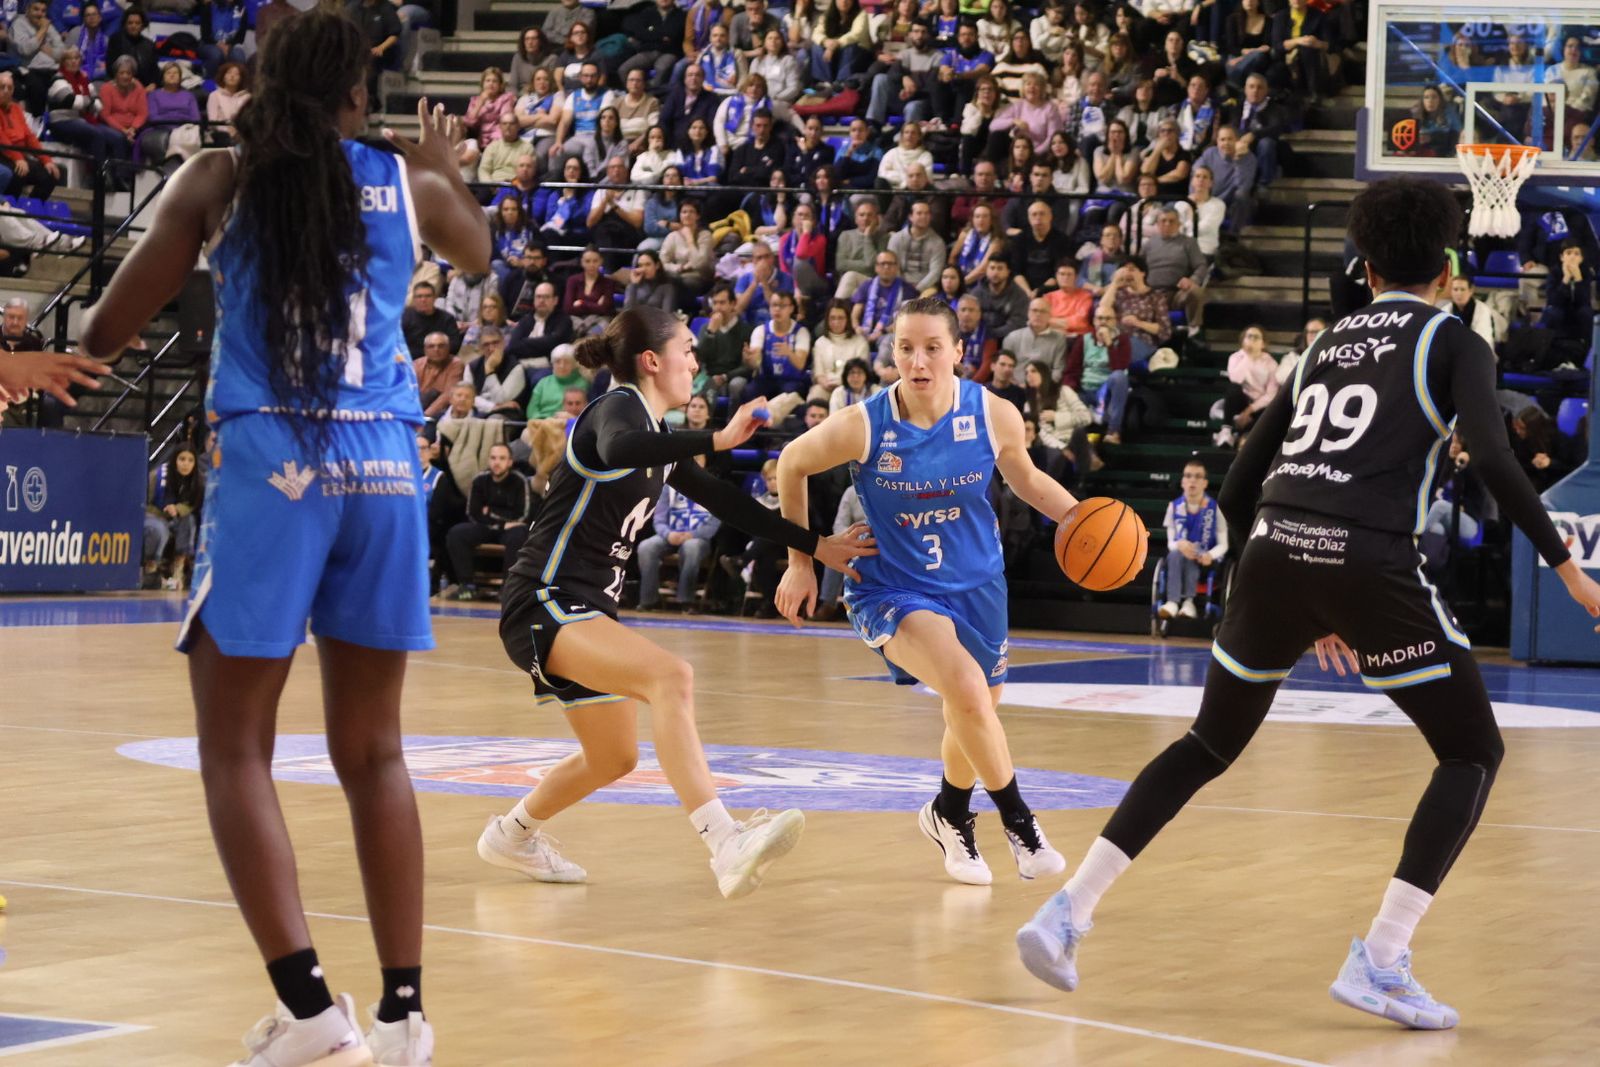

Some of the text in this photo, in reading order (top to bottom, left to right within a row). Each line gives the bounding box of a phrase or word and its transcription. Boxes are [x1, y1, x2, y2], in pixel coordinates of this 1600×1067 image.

[1333, 311, 1413, 333] ODOM
[1317, 342, 1367, 365] MGS
[1282, 383, 1377, 456] 99
[875, 471, 983, 491] CASTILLA Y LEÓN
[0, 519, 131, 565] avenida.com
[1270, 528, 1346, 552] Jiménez Díaz
[1298, 523, 1349, 538] Fundación
[922, 534, 943, 570] 3
[1366, 640, 1436, 667] MADRID
